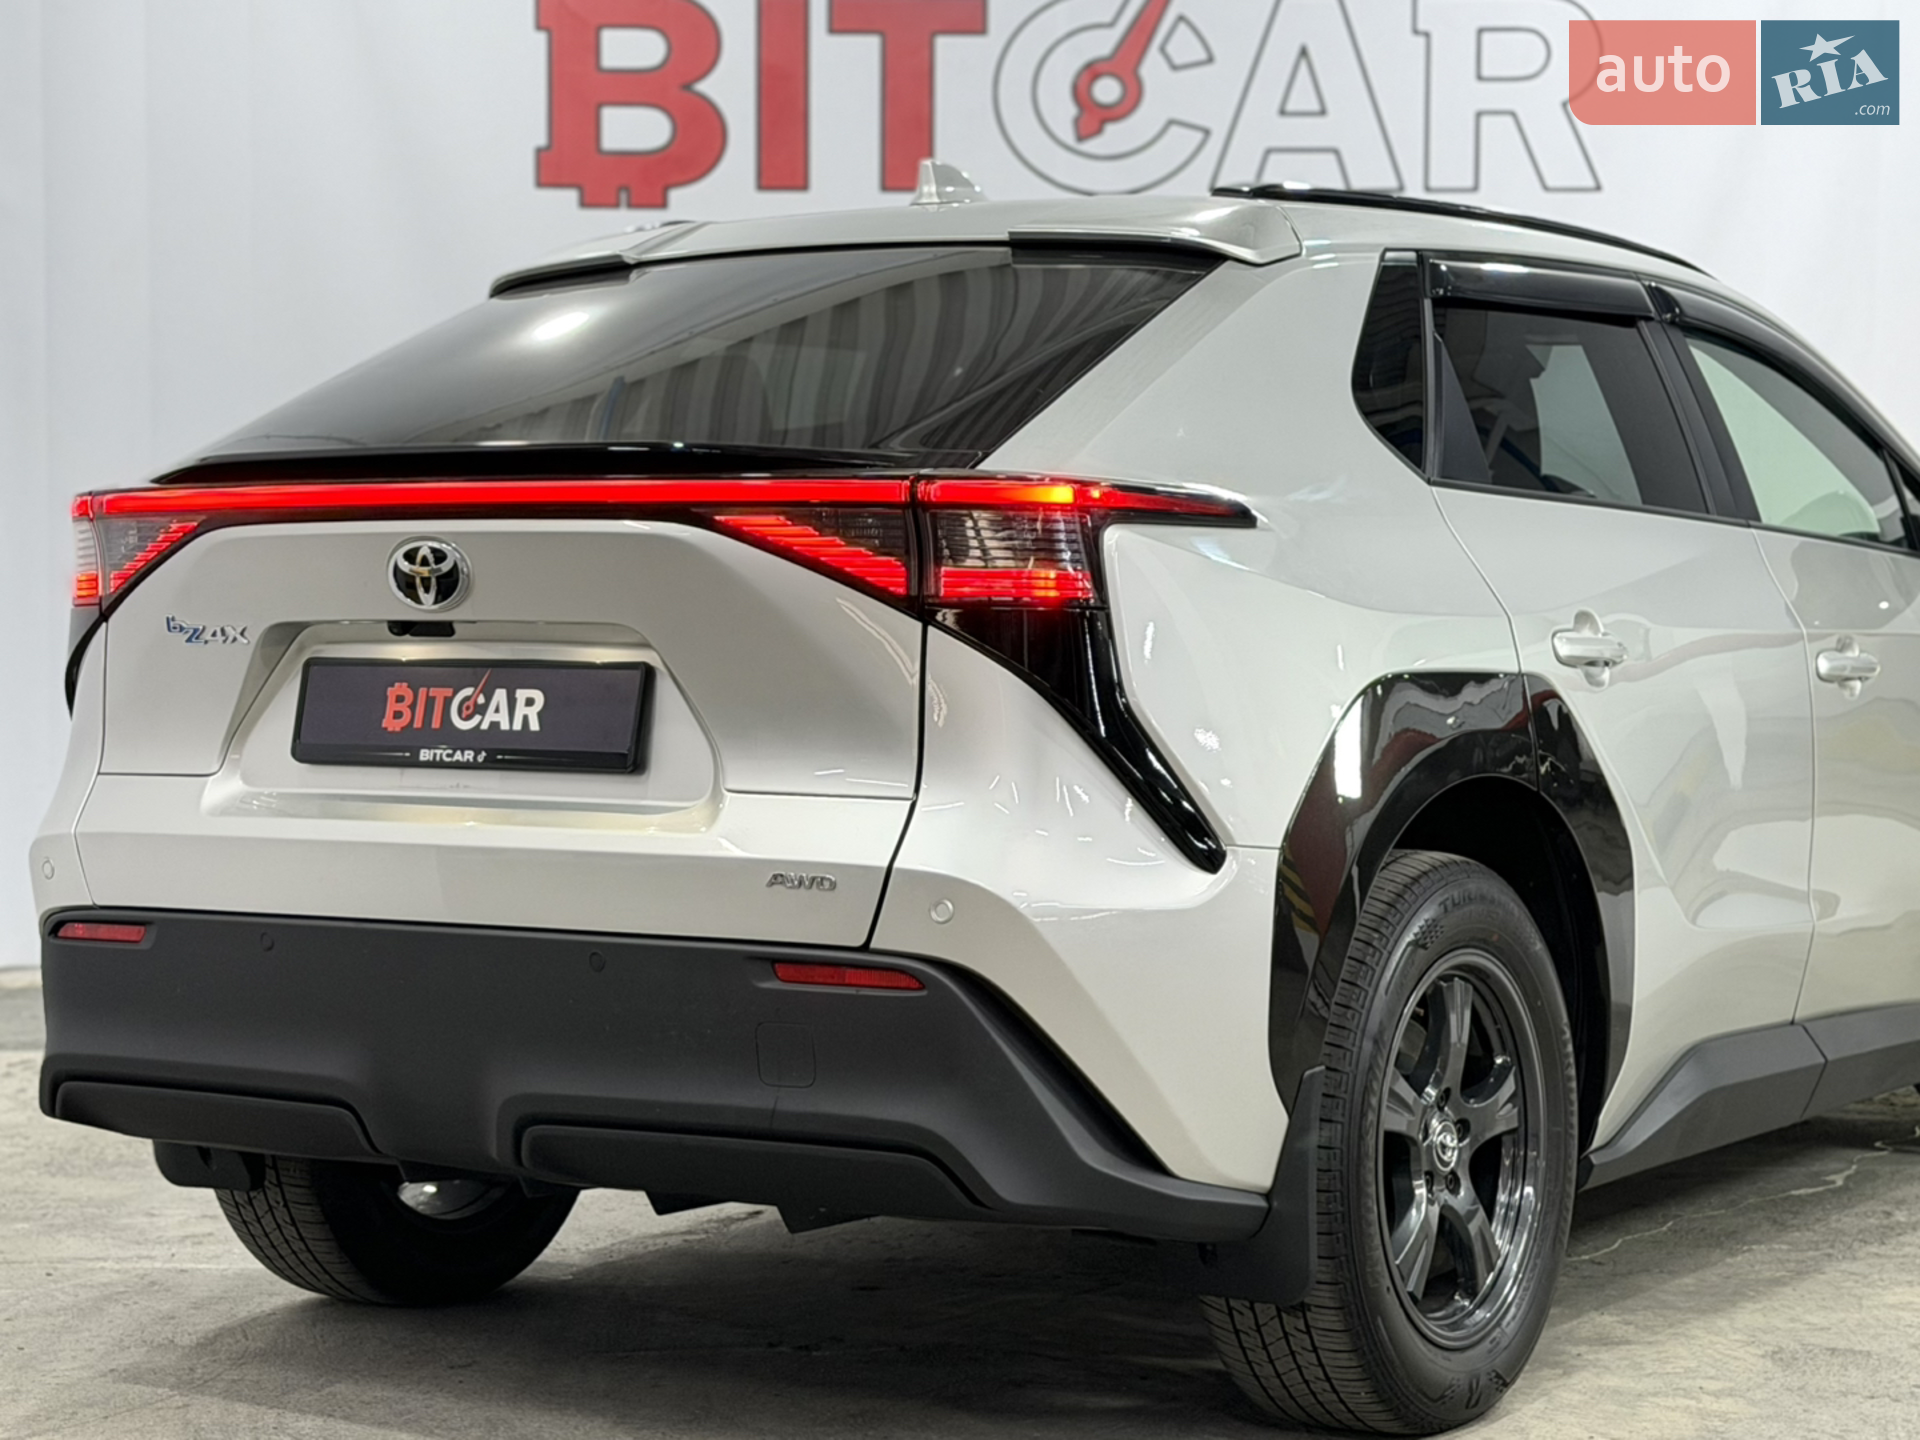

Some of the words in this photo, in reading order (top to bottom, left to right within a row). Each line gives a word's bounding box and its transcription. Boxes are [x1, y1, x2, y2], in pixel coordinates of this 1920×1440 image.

[536, 0, 1601, 208] BITCAR
[381, 669, 545, 732] BITCAR
[418, 748, 475, 763] BITCAR
[765, 871, 837, 892] AWD
